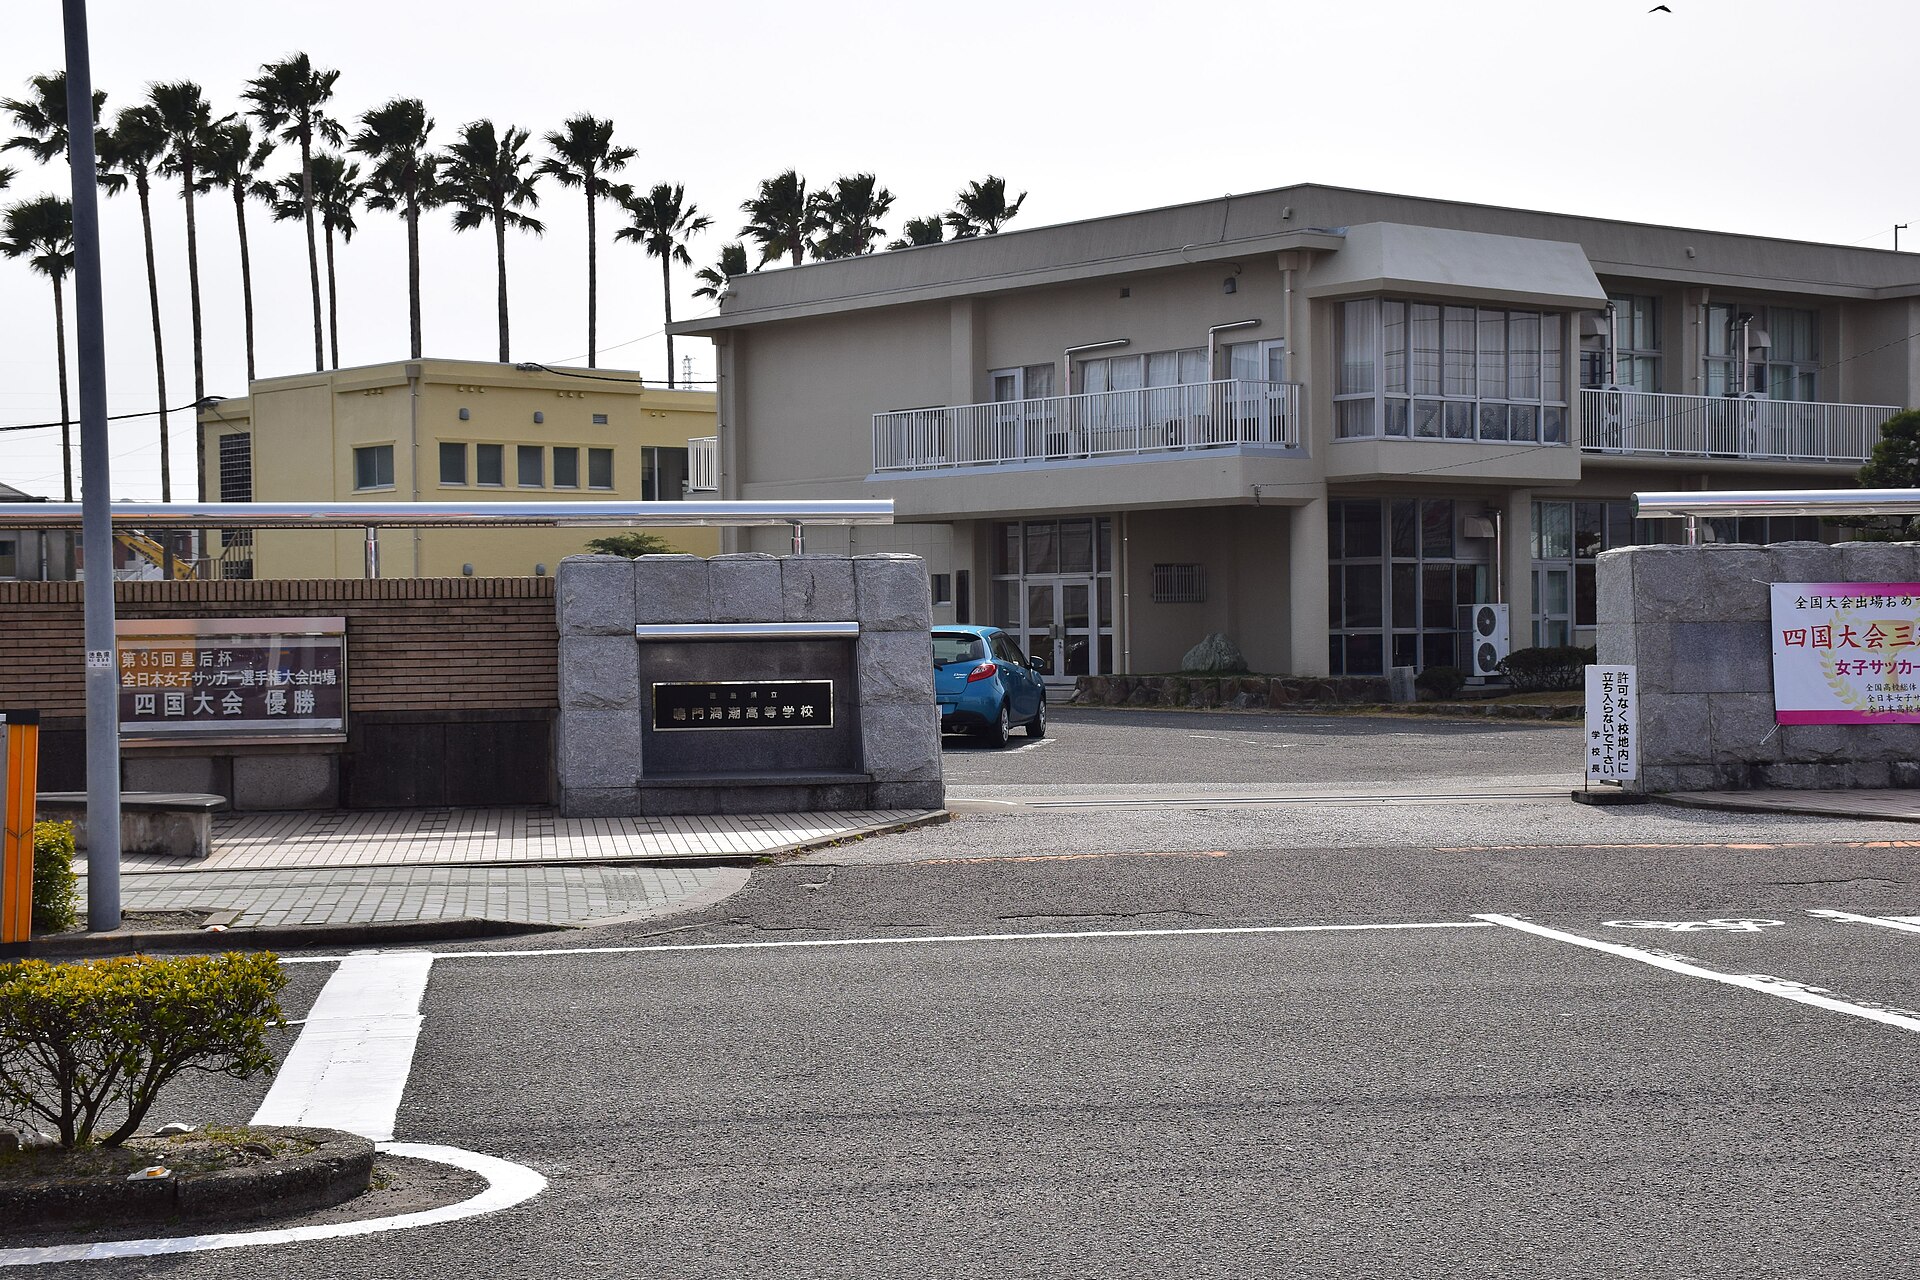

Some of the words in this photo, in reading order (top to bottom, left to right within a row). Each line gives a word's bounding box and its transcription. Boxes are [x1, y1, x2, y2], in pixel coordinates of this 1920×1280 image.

[1794, 594, 1920, 610] 全国大会出場おめ
[1782, 623, 1920, 650] 四国大会三
[121, 669, 337, 688] 全日本女子サッカー選手権大会出場
[1866, 683, 1917, 692] 全国高校総体
[135, 691, 244, 716] 四国大会
[264, 689, 316, 715] 優勝
[672, 705, 814, 722] 鳴門渦潮高等学校
[1617, 671, 1629, 774] 許可なく校地内に
[1591, 730, 1600, 773] 学校長
